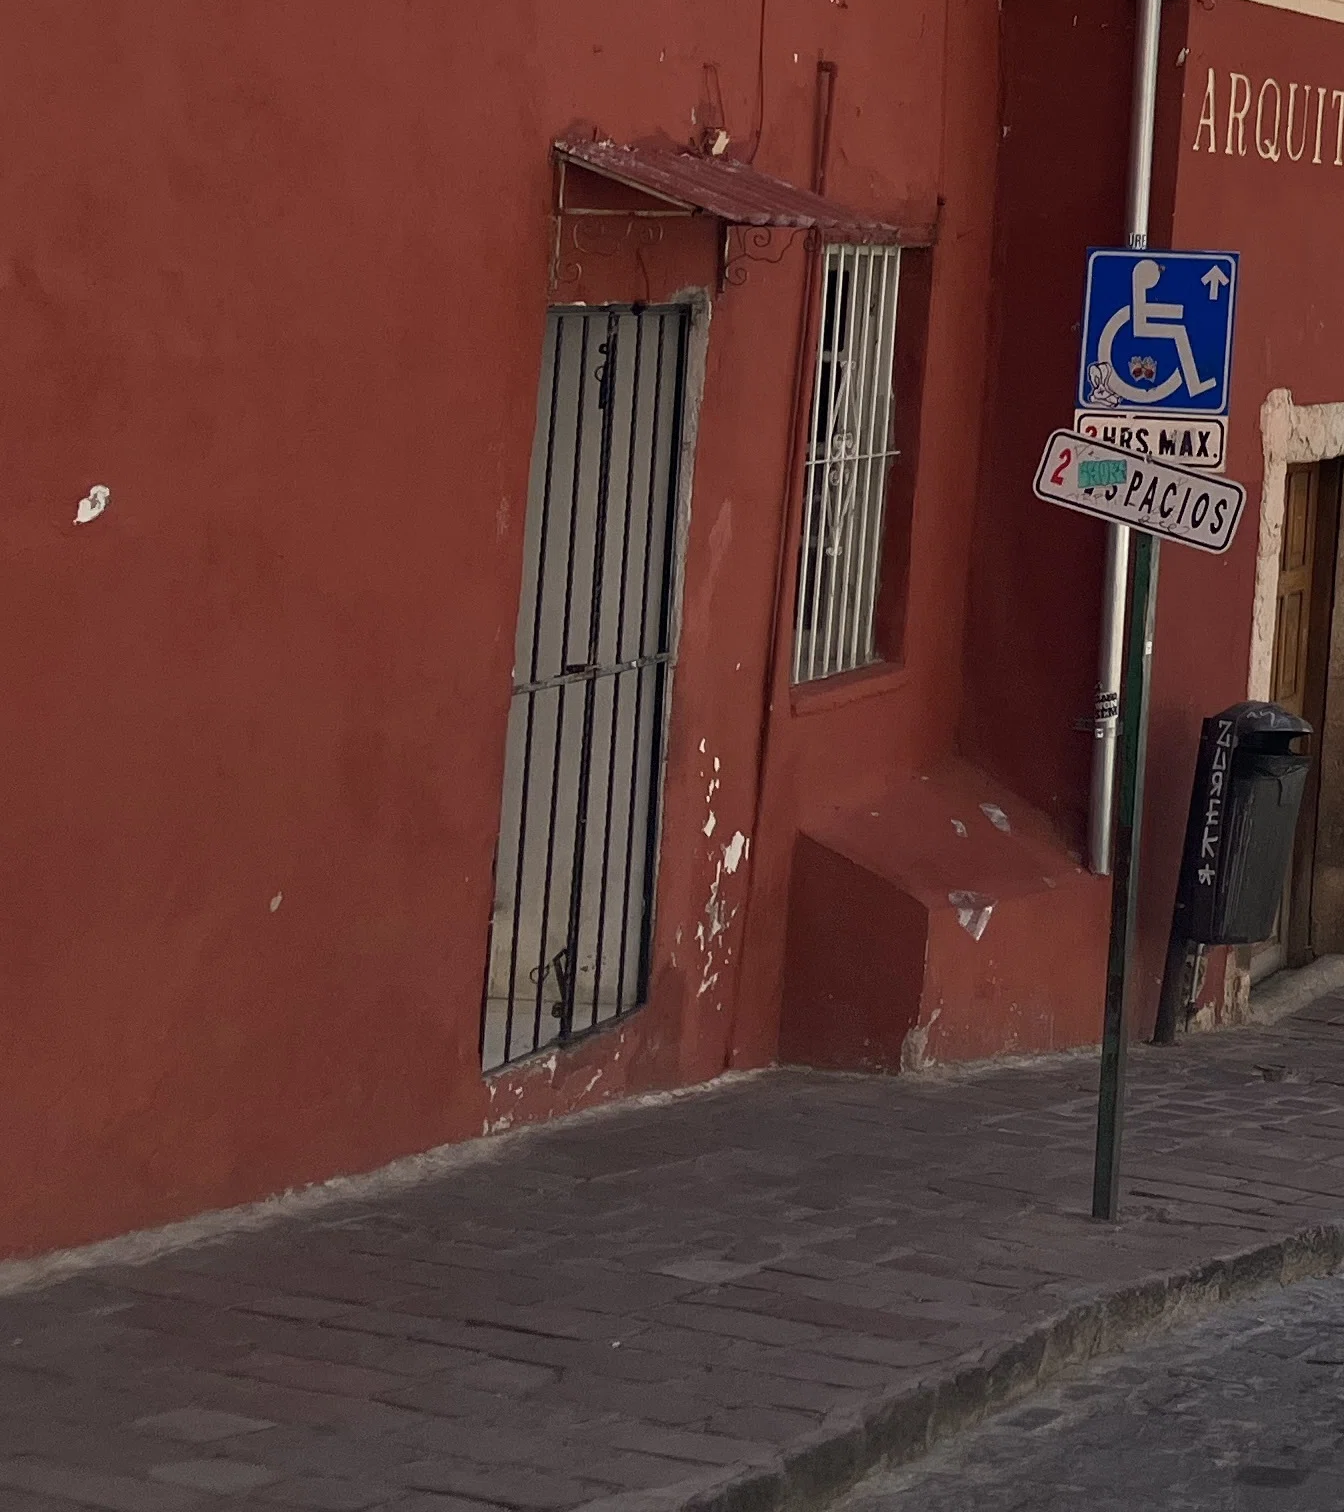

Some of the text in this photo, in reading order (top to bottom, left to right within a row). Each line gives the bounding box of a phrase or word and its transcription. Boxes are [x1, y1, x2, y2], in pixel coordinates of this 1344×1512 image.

[1103, 426, 1153, 455] HRS.
[1159, 429, 1218, 458] MAX.
[1050, 448, 1072, 486] 2
[1084, 470, 1228, 534] PACIOS
